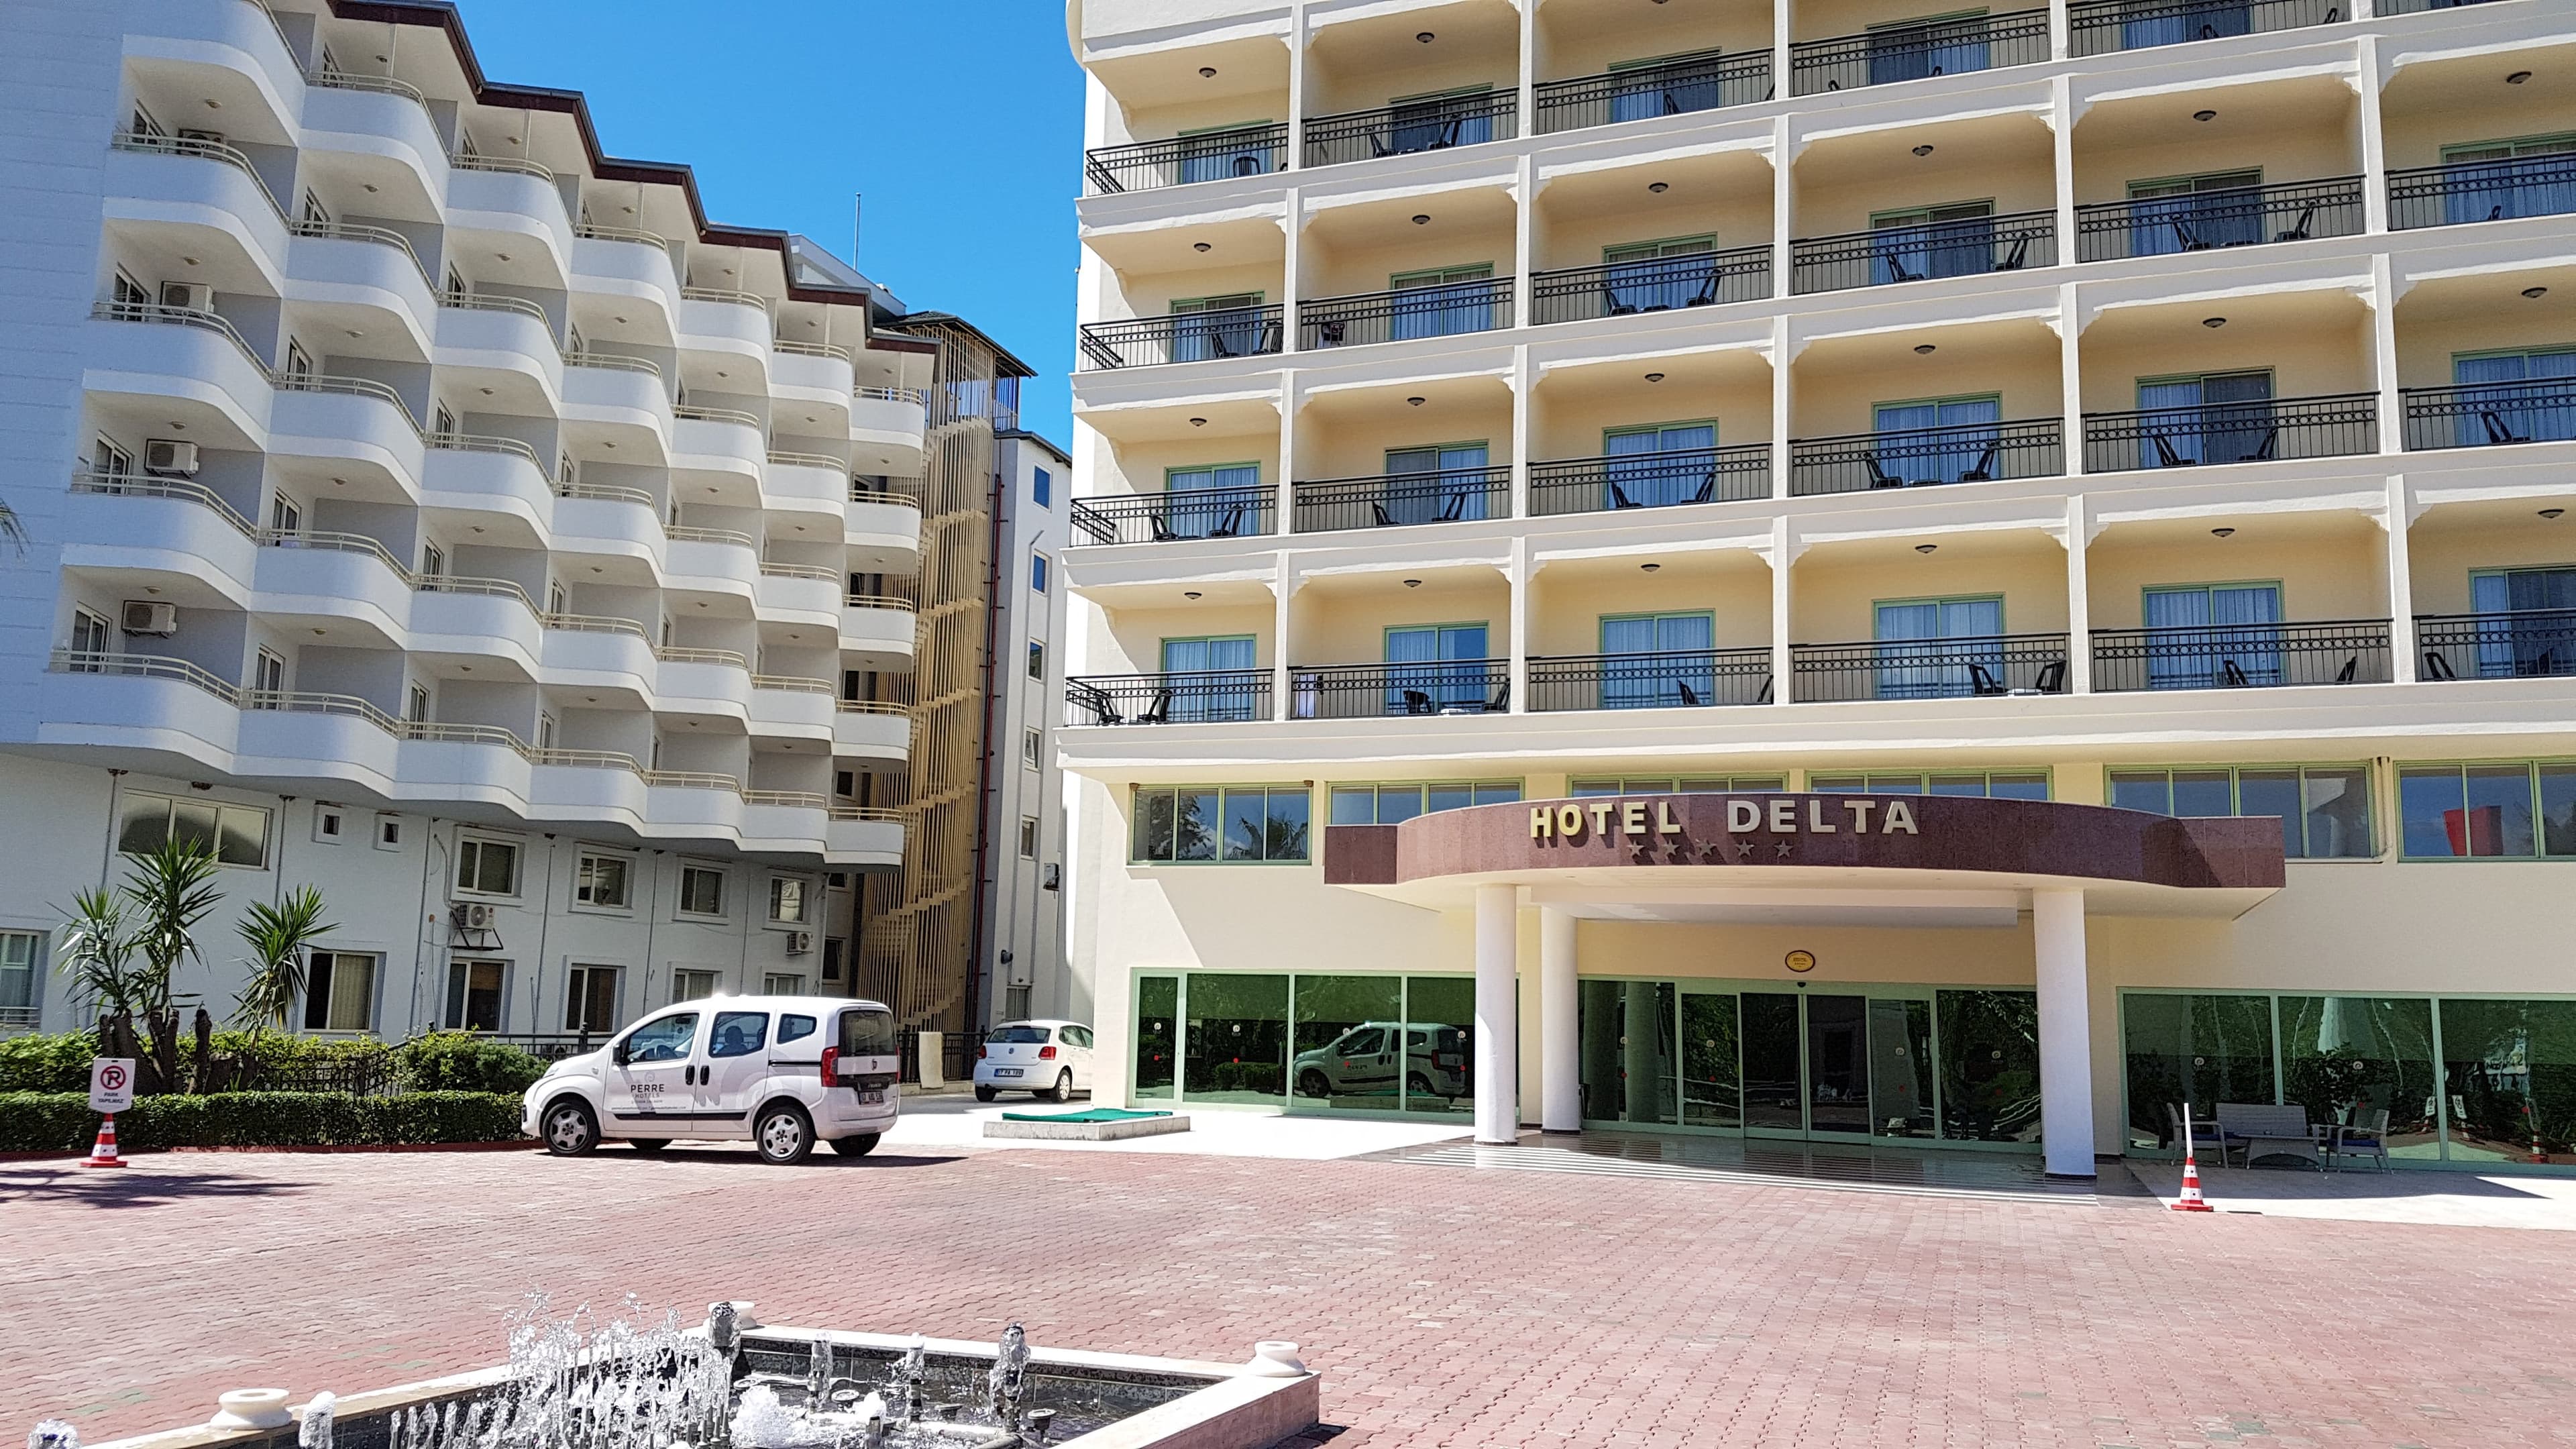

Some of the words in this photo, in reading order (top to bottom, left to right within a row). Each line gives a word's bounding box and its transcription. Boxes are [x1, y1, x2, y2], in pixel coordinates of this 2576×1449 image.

[1529, 801, 1681, 839] HOTEL
[1727, 800, 1919, 835] DELTA
[631, 1083, 665, 1093] PERRE
